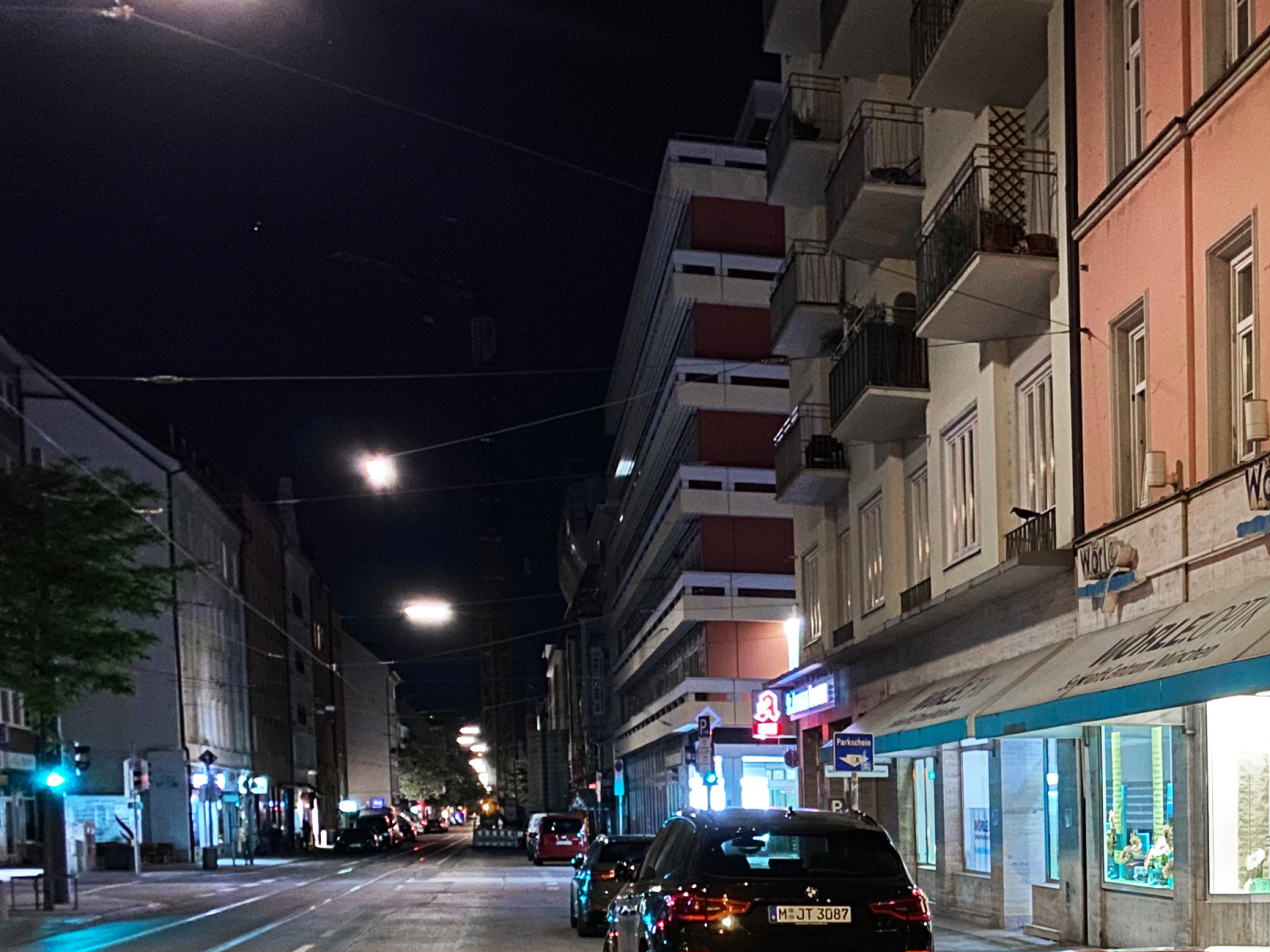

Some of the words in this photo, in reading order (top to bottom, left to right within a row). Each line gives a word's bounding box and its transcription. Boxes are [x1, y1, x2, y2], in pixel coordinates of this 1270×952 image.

[836, 737, 871, 747] Parkschein
[832, 800, 843, 813] P
[778, 908, 787, 920] M
[796, 908, 813, 920] JT
[817, 908, 849, 920] 3087
